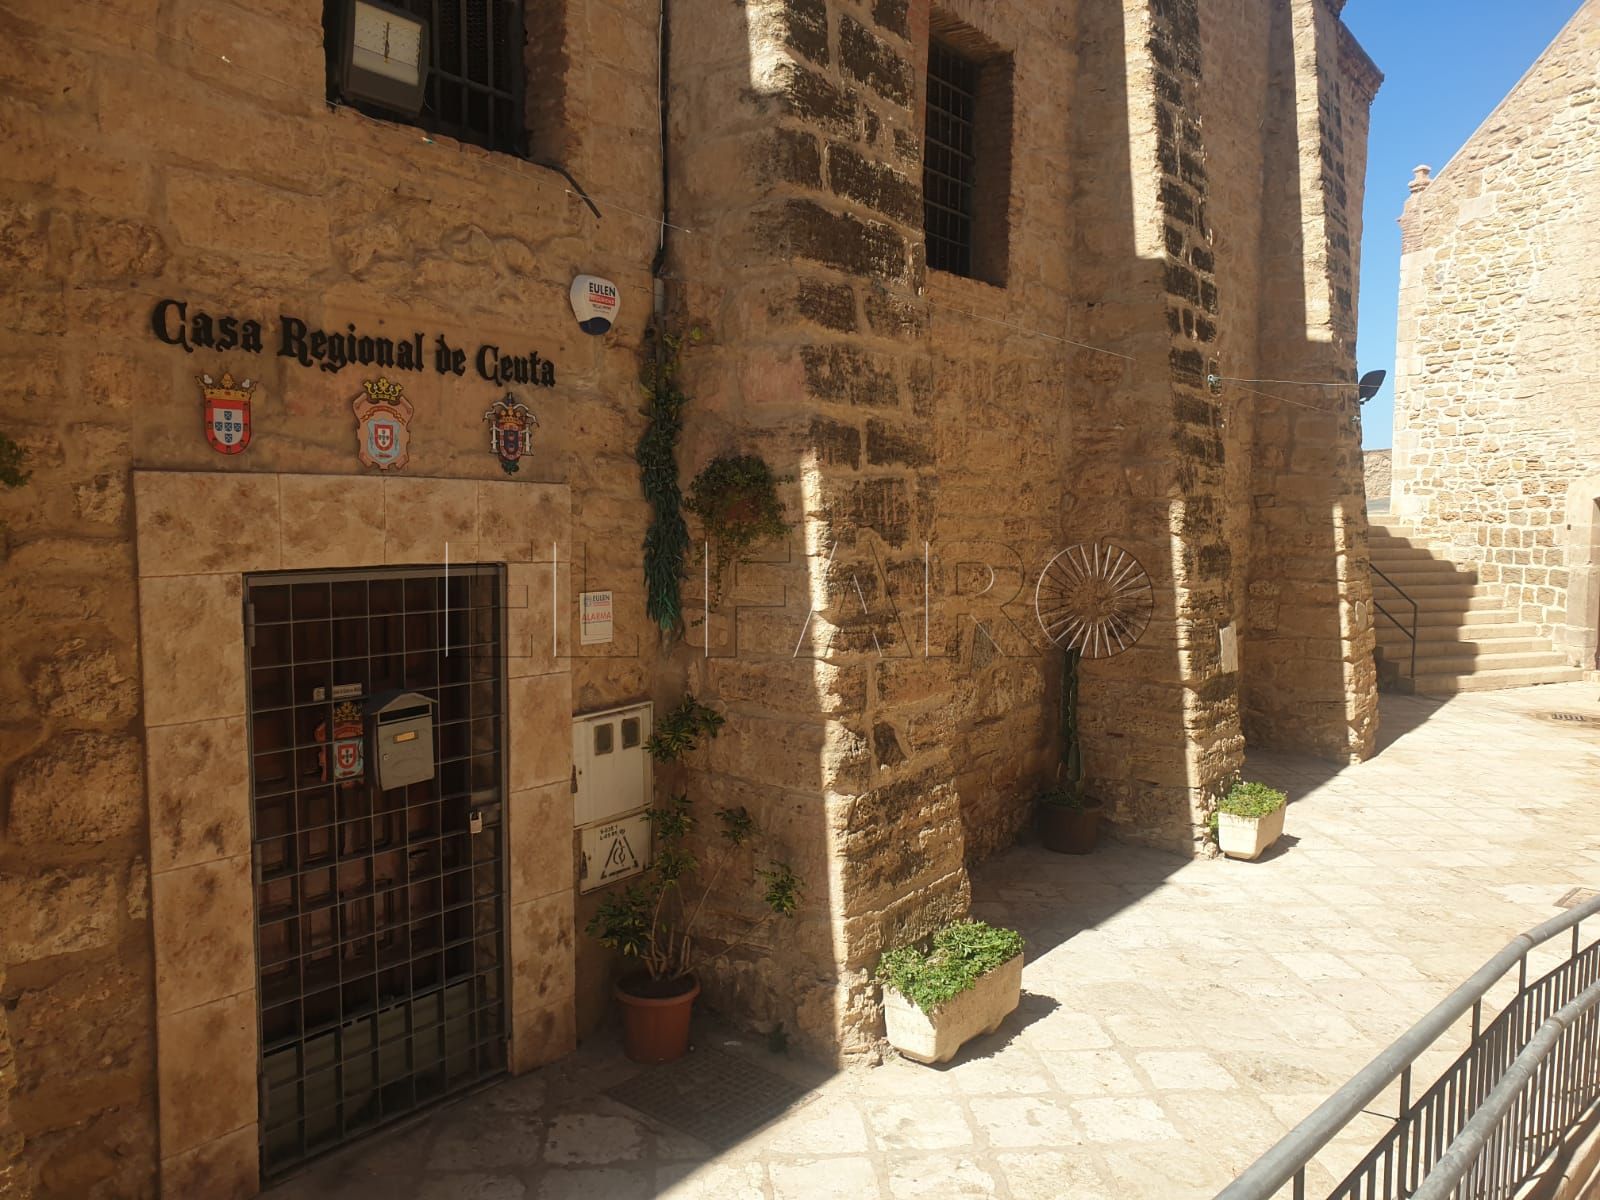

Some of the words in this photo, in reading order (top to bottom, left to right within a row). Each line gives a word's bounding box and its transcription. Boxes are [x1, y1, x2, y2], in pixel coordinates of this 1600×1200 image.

[589, 282, 615, 297] EULEN
[152, 299, 263, 353] Casa
[277, 315, 424, 374] Regional
[436, 334, 466, 376] de
[477, 345, 556, 388] Ceuta
[582, 612, 611, 621] ALARMA
